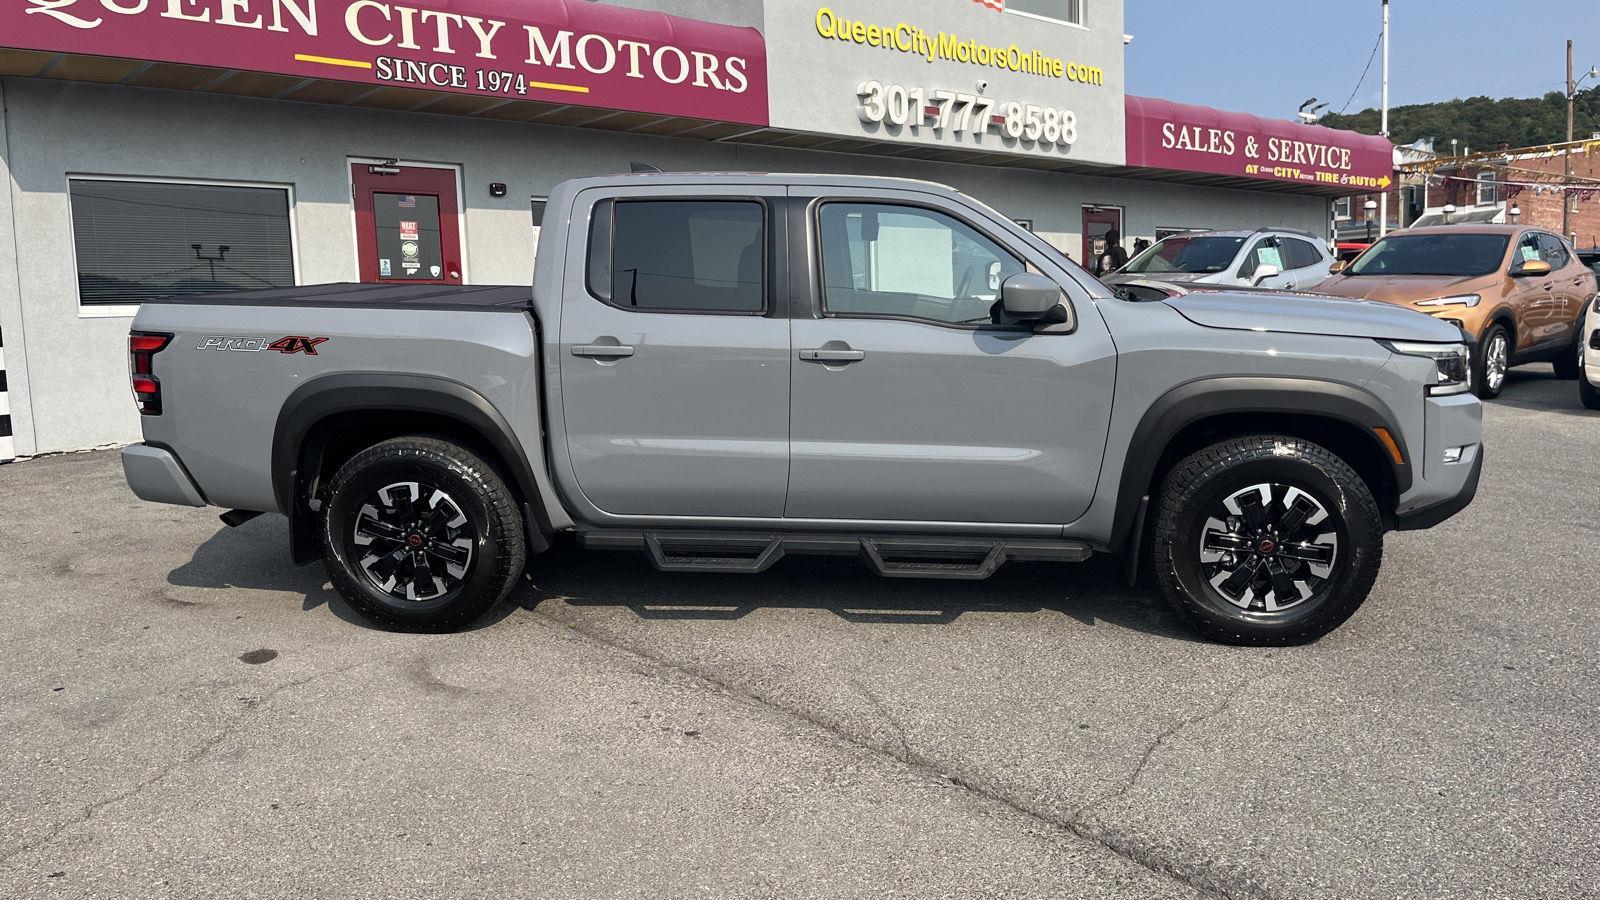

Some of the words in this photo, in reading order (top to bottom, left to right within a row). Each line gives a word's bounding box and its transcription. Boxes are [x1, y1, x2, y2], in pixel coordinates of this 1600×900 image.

[344, 0, 505, 60] CITY
[524, 25, 748, 93] MOTORS
[816, 7, 1063, 78] QueenCityMotorsOnline
[376, 57, 467, 88] SINCE
[475, 70, 527, 95] 1974
[856, 80, 1077, 145] 301-777-8588
[1162, 122, 1235, 155] SALES
[1244, 136, 1259, 159] &
[1268, 137, 1351, 170] SERVICE
[1245, 164, 1259, 175] AT
[1274, 166, 1300, 179] CITY
[1315, 171, 1339, 183] TIRE
[1340, 173, 1350, 185] &
[1349, 175, 1376, 187] AUTO
